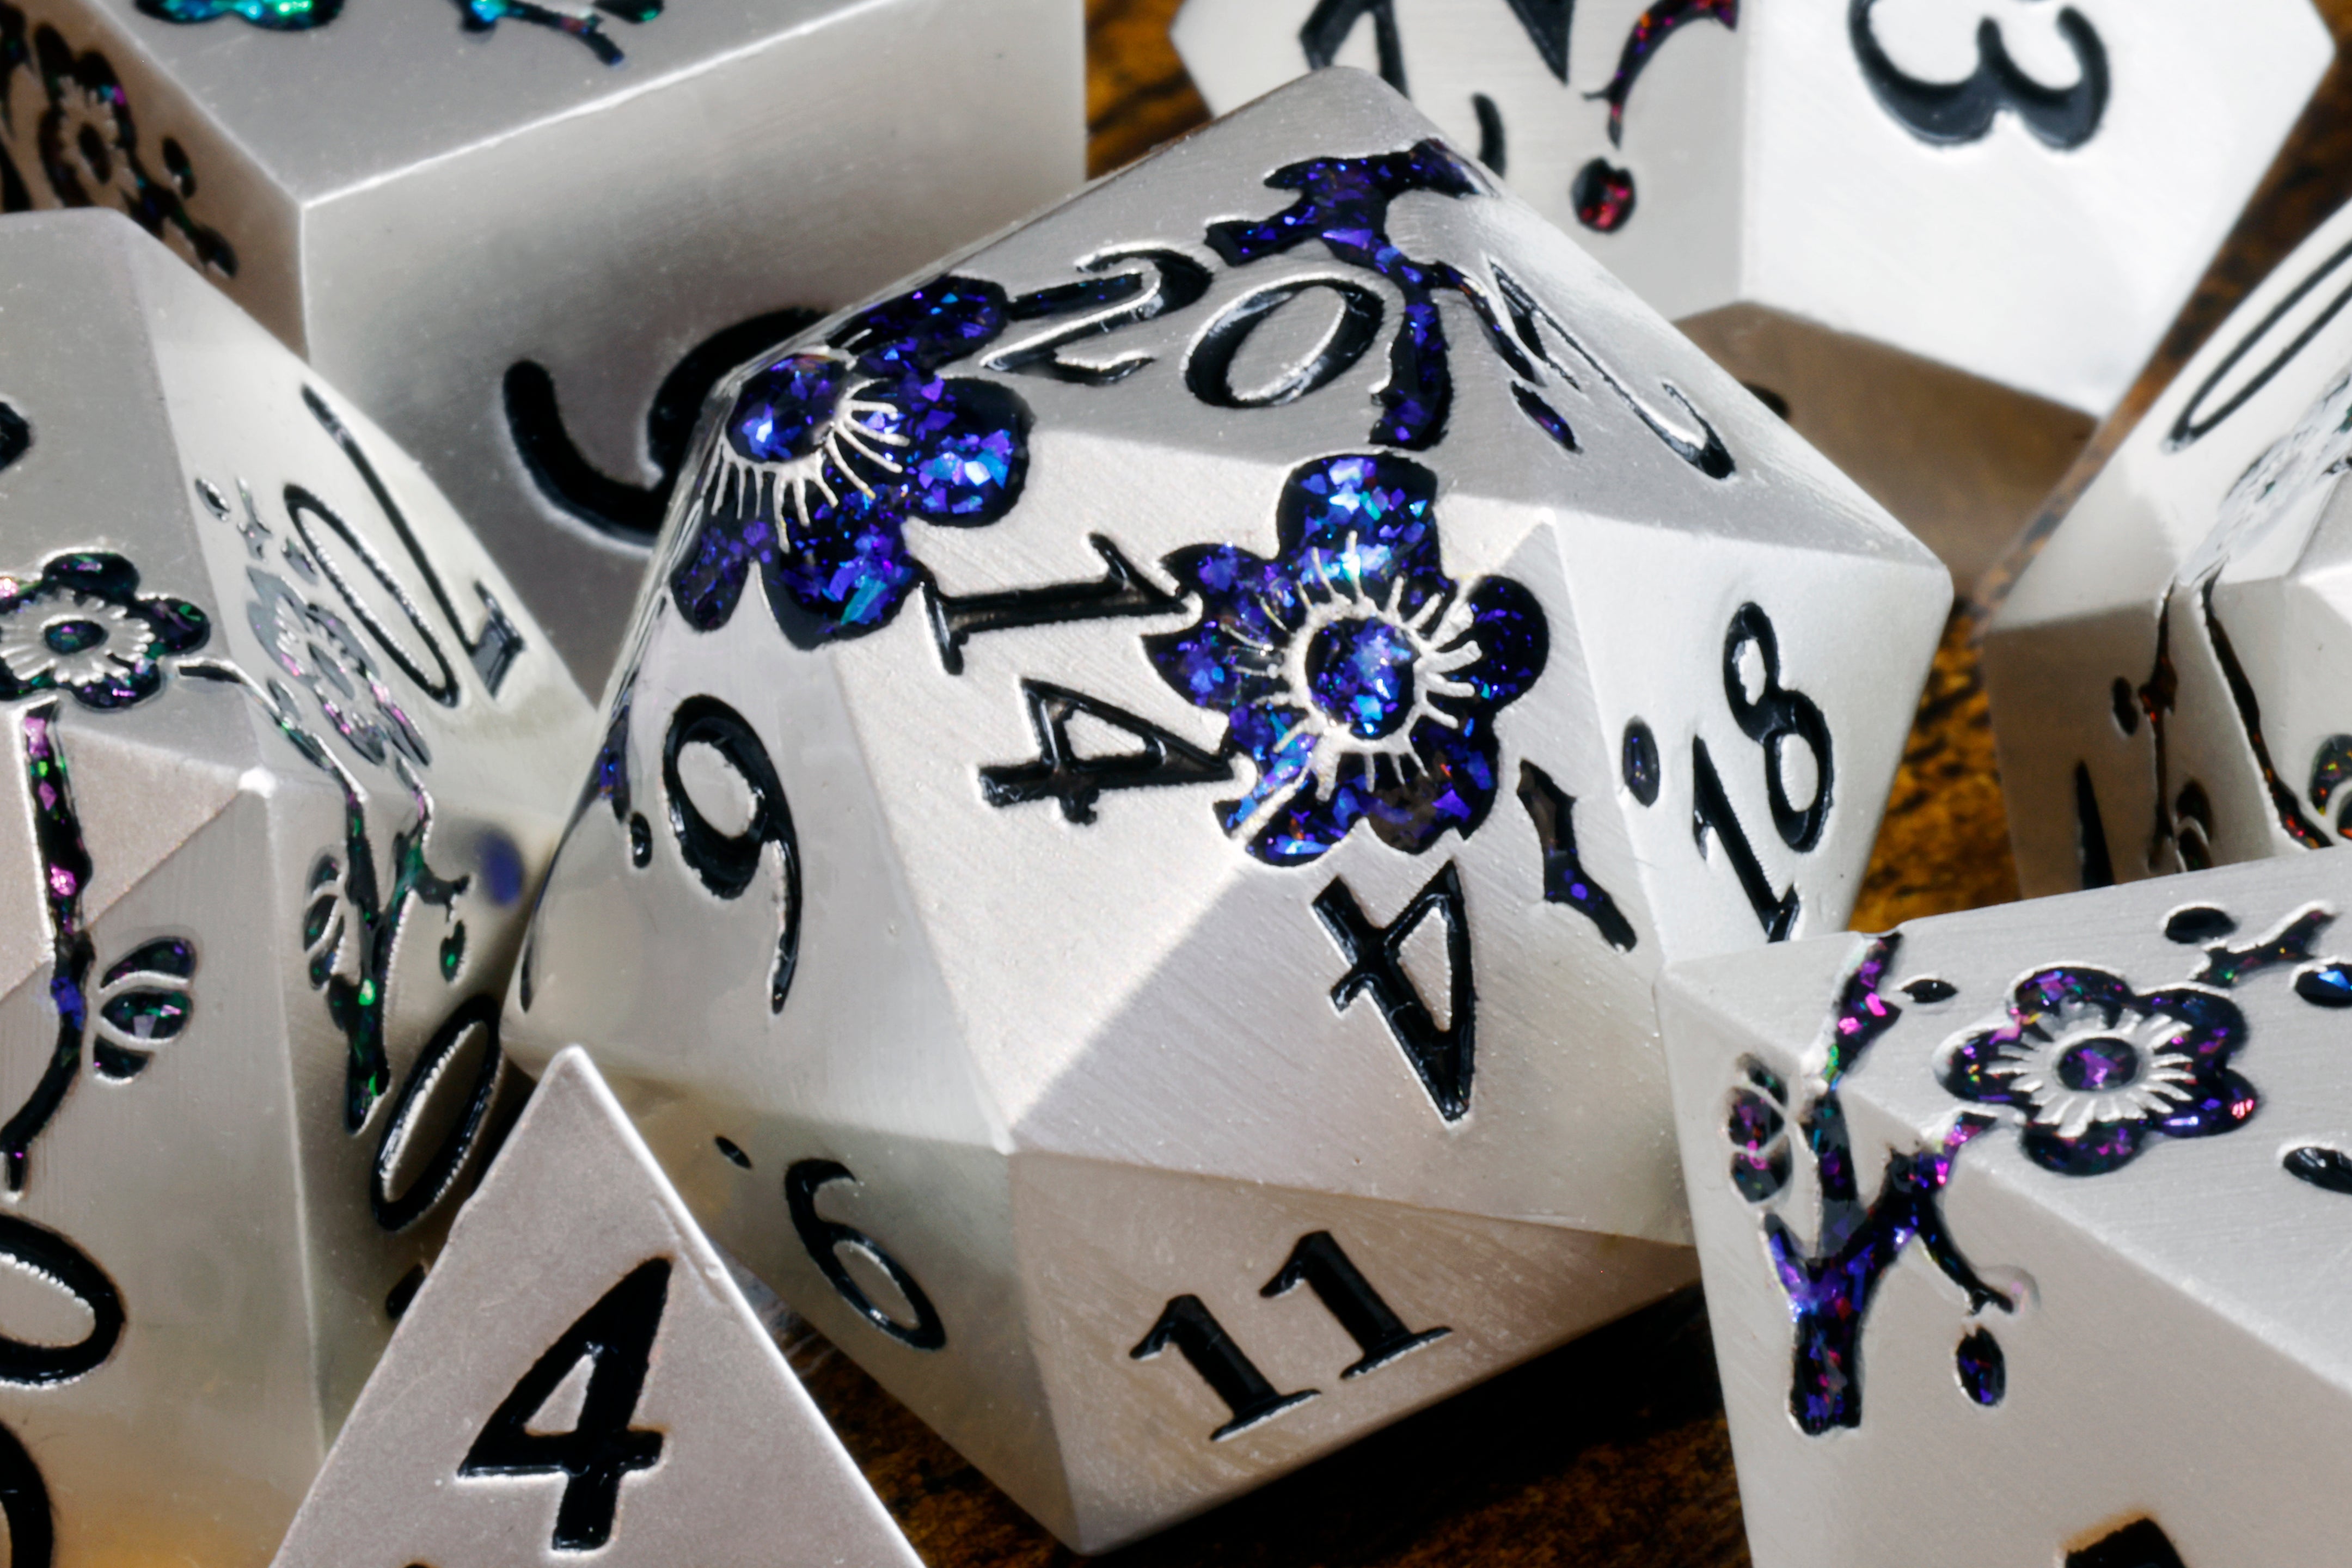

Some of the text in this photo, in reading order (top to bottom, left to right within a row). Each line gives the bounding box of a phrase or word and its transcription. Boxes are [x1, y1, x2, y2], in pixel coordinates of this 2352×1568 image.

[981, 244, 1384, 408] 20
[921, 533, 1235, 825] 14
[1692, 602, 1834, 942] 18
[1312, 860, 1477, 1122] 4
[458, 1255, 673, 1551] 4
[1128, 1230, 1453, 1442] 11
